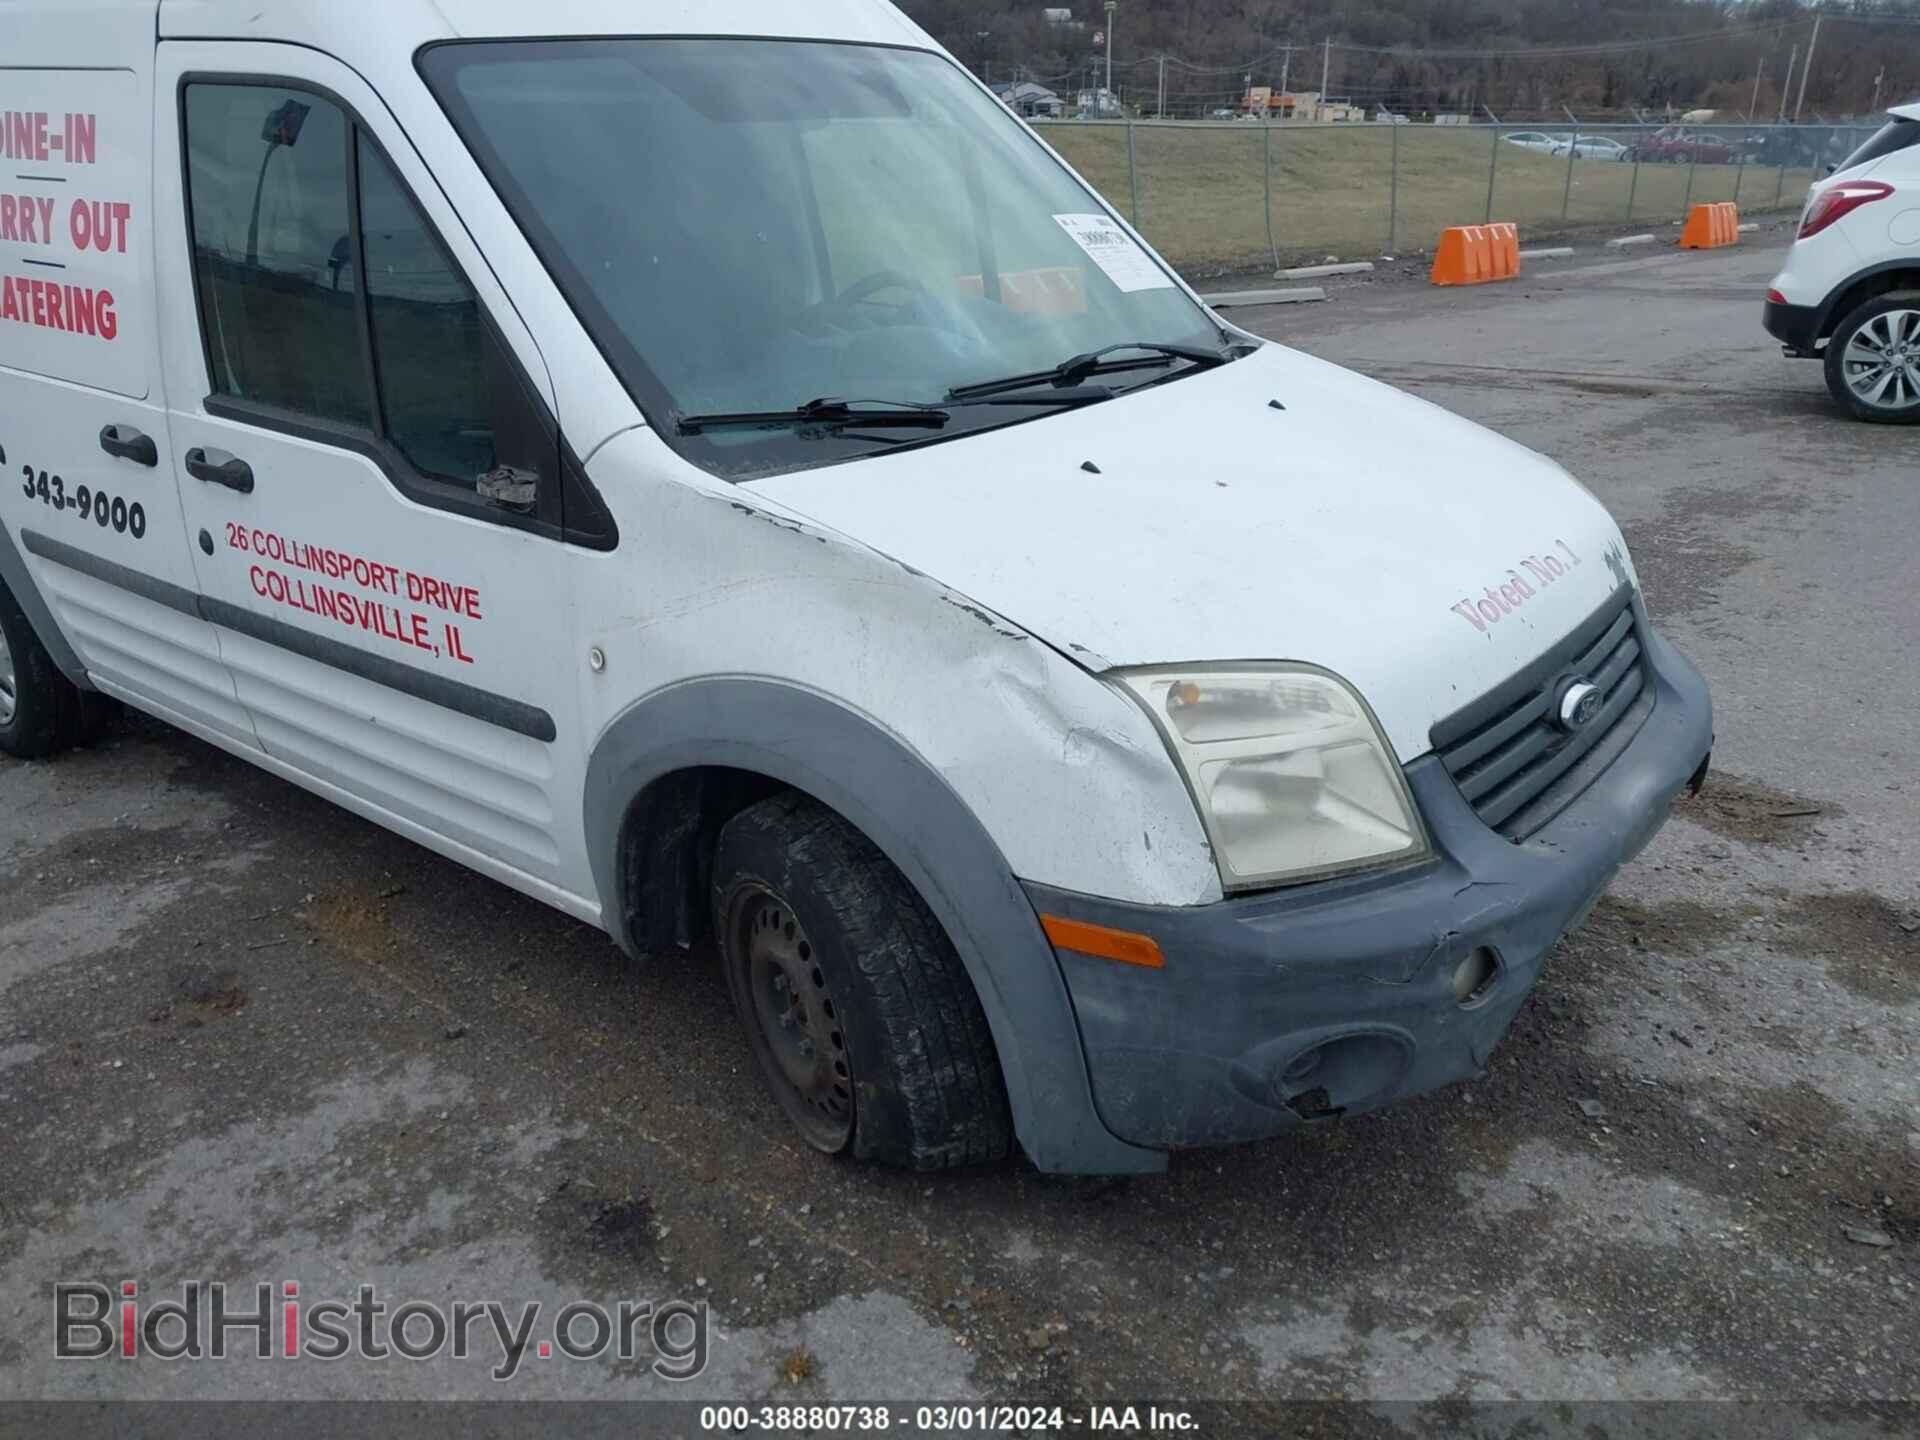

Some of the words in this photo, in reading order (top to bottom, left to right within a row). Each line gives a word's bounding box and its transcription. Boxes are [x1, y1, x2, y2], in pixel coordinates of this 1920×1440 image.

[0, 194, 55, 245] RRY
[70, 199, 130, 253] OUT
[0, 275, 118, 340] ATERING
[22, 464, 146, 539] 343-9000
[226, 522, 249, 551] 26
[252, 529, 399, 595] COLLINSPORT
[406, 571, 482, 620] DRIVE
[1450, 568, 1537, 633] Voted
[250, 565, 440, 658] COLLINSVILLE,
[445, 624, 474, 663] IL
